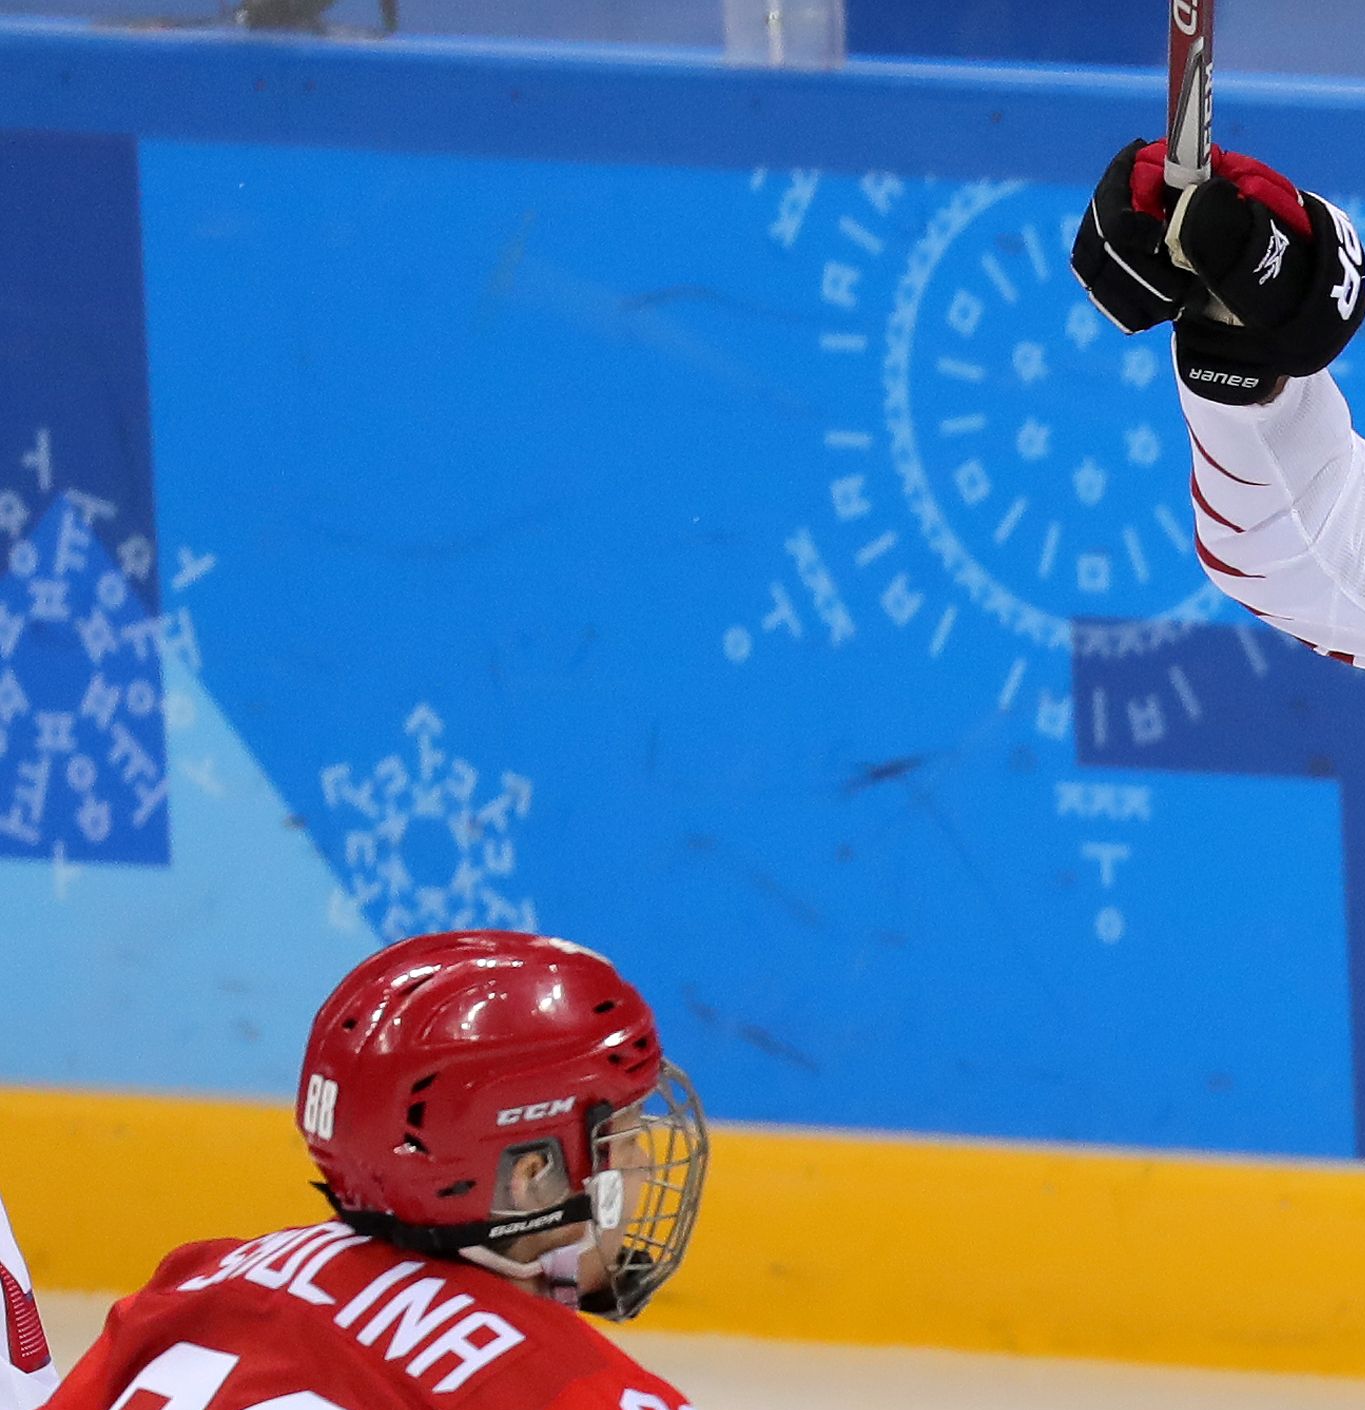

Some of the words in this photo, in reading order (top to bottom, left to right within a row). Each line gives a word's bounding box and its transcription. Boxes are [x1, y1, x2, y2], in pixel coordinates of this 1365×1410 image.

[1189, 367, 1260, 389] BAUER
[302, 1073, 339, 1141] 88
[495, 1094, 578, 1128] CCM
